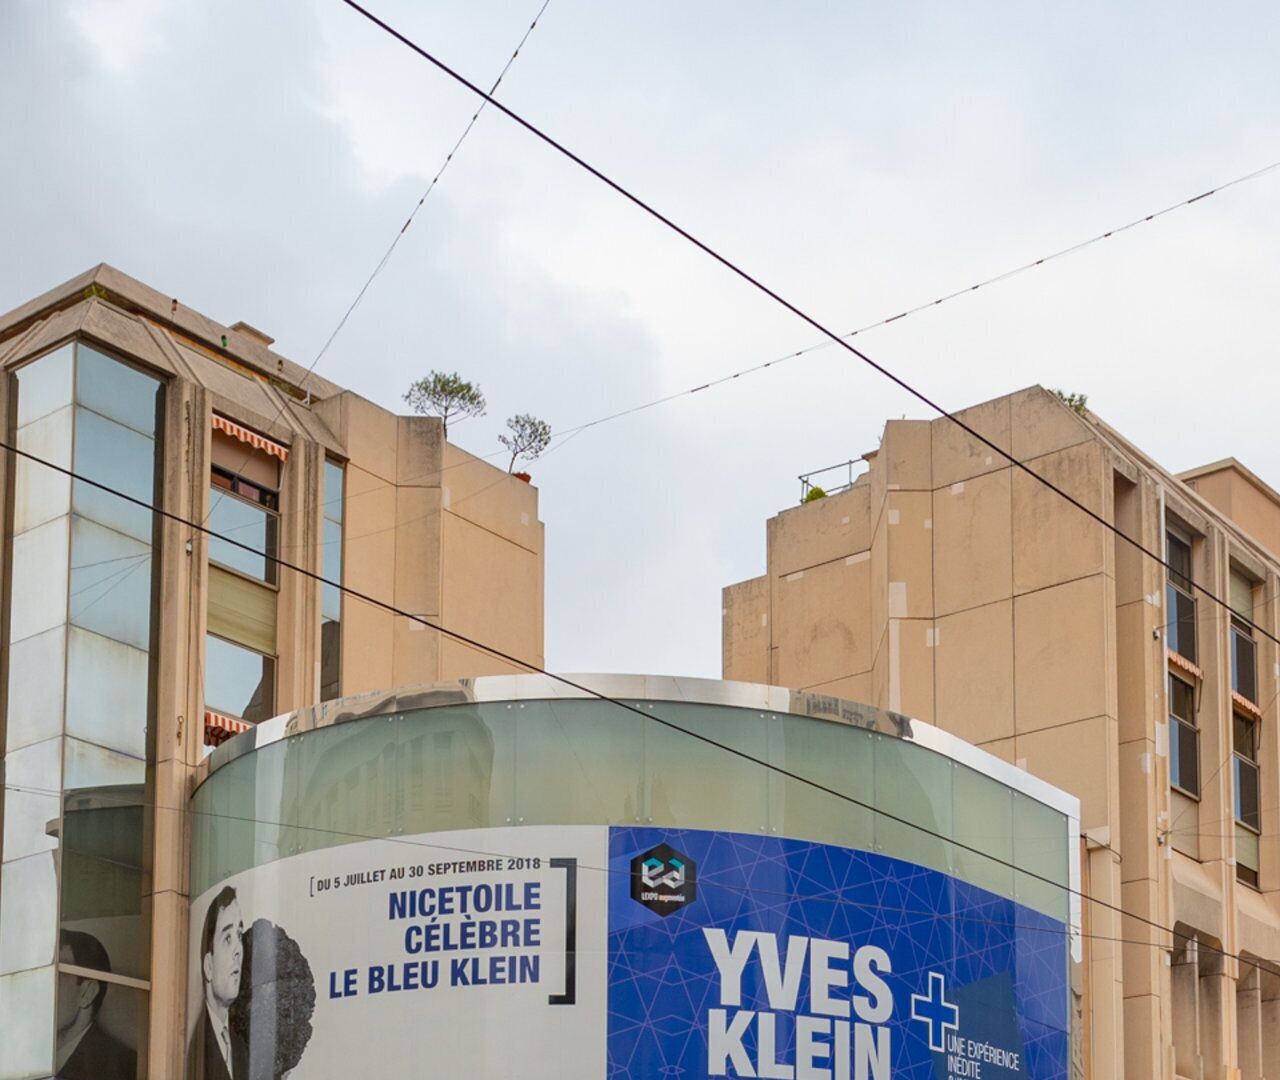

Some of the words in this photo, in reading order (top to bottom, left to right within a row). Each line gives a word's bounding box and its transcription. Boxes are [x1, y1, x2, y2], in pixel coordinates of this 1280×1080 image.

[317, 879, 331, 892] DU
[334, 878, 341, 889] 5
[343, 869, 386, 887] JUILLET
[389, 867, 405, 880] AU
[408, 865, 424, 878] 30
[427, 859, 504, 876] SEPTEMBRE
[507, 858, 541, 870] 2018
[388, 882, 541, 920] NICETOILE
[404, 915, 541, 954] CÉLÈBRE
[329, 968, 358, 999] LE
[368, 960, 439, 994] BLEU
[450, 955, 540, 986] KLEIN
[702, 927, 893, 1024] YVES
[946, 1035, 966, 1055] UNE
[967, 1039, 1020, 1071] EXPÉRIENCE
[947, 1055, 981, 1079] INÉDITE
